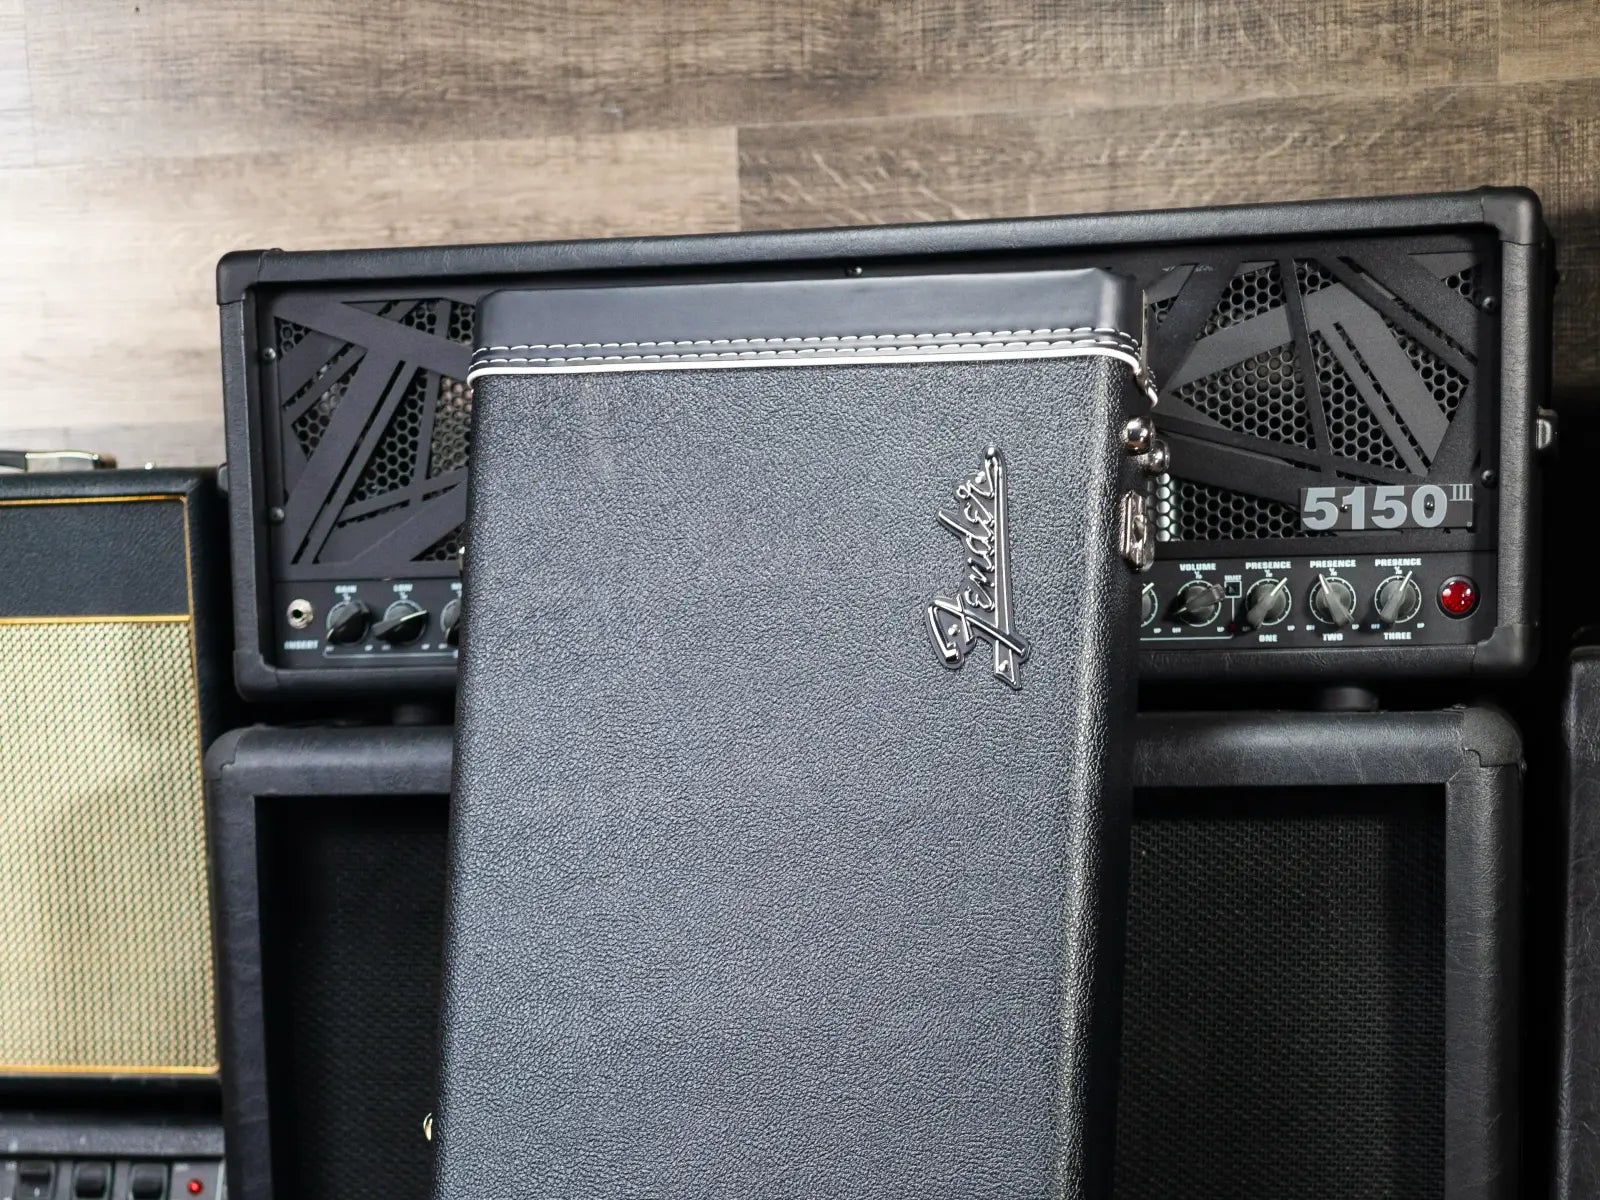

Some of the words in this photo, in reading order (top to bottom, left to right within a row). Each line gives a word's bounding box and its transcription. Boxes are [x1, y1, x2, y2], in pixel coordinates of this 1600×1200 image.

[1245, 561, 1292, 569] PRESENCE
[1310, 560, 1357, 568] PRESENCE
[1374, 558, 1422, 567] PRESENCE
[926, 446, 1028, 690] Fender
[1179, 563, 1216, 571] VOLUME
[1258, 634, 1278, 642] ONE
[1322, 633, 1343, 641] TWO
[1383, 631, 1412, 640] THREE
